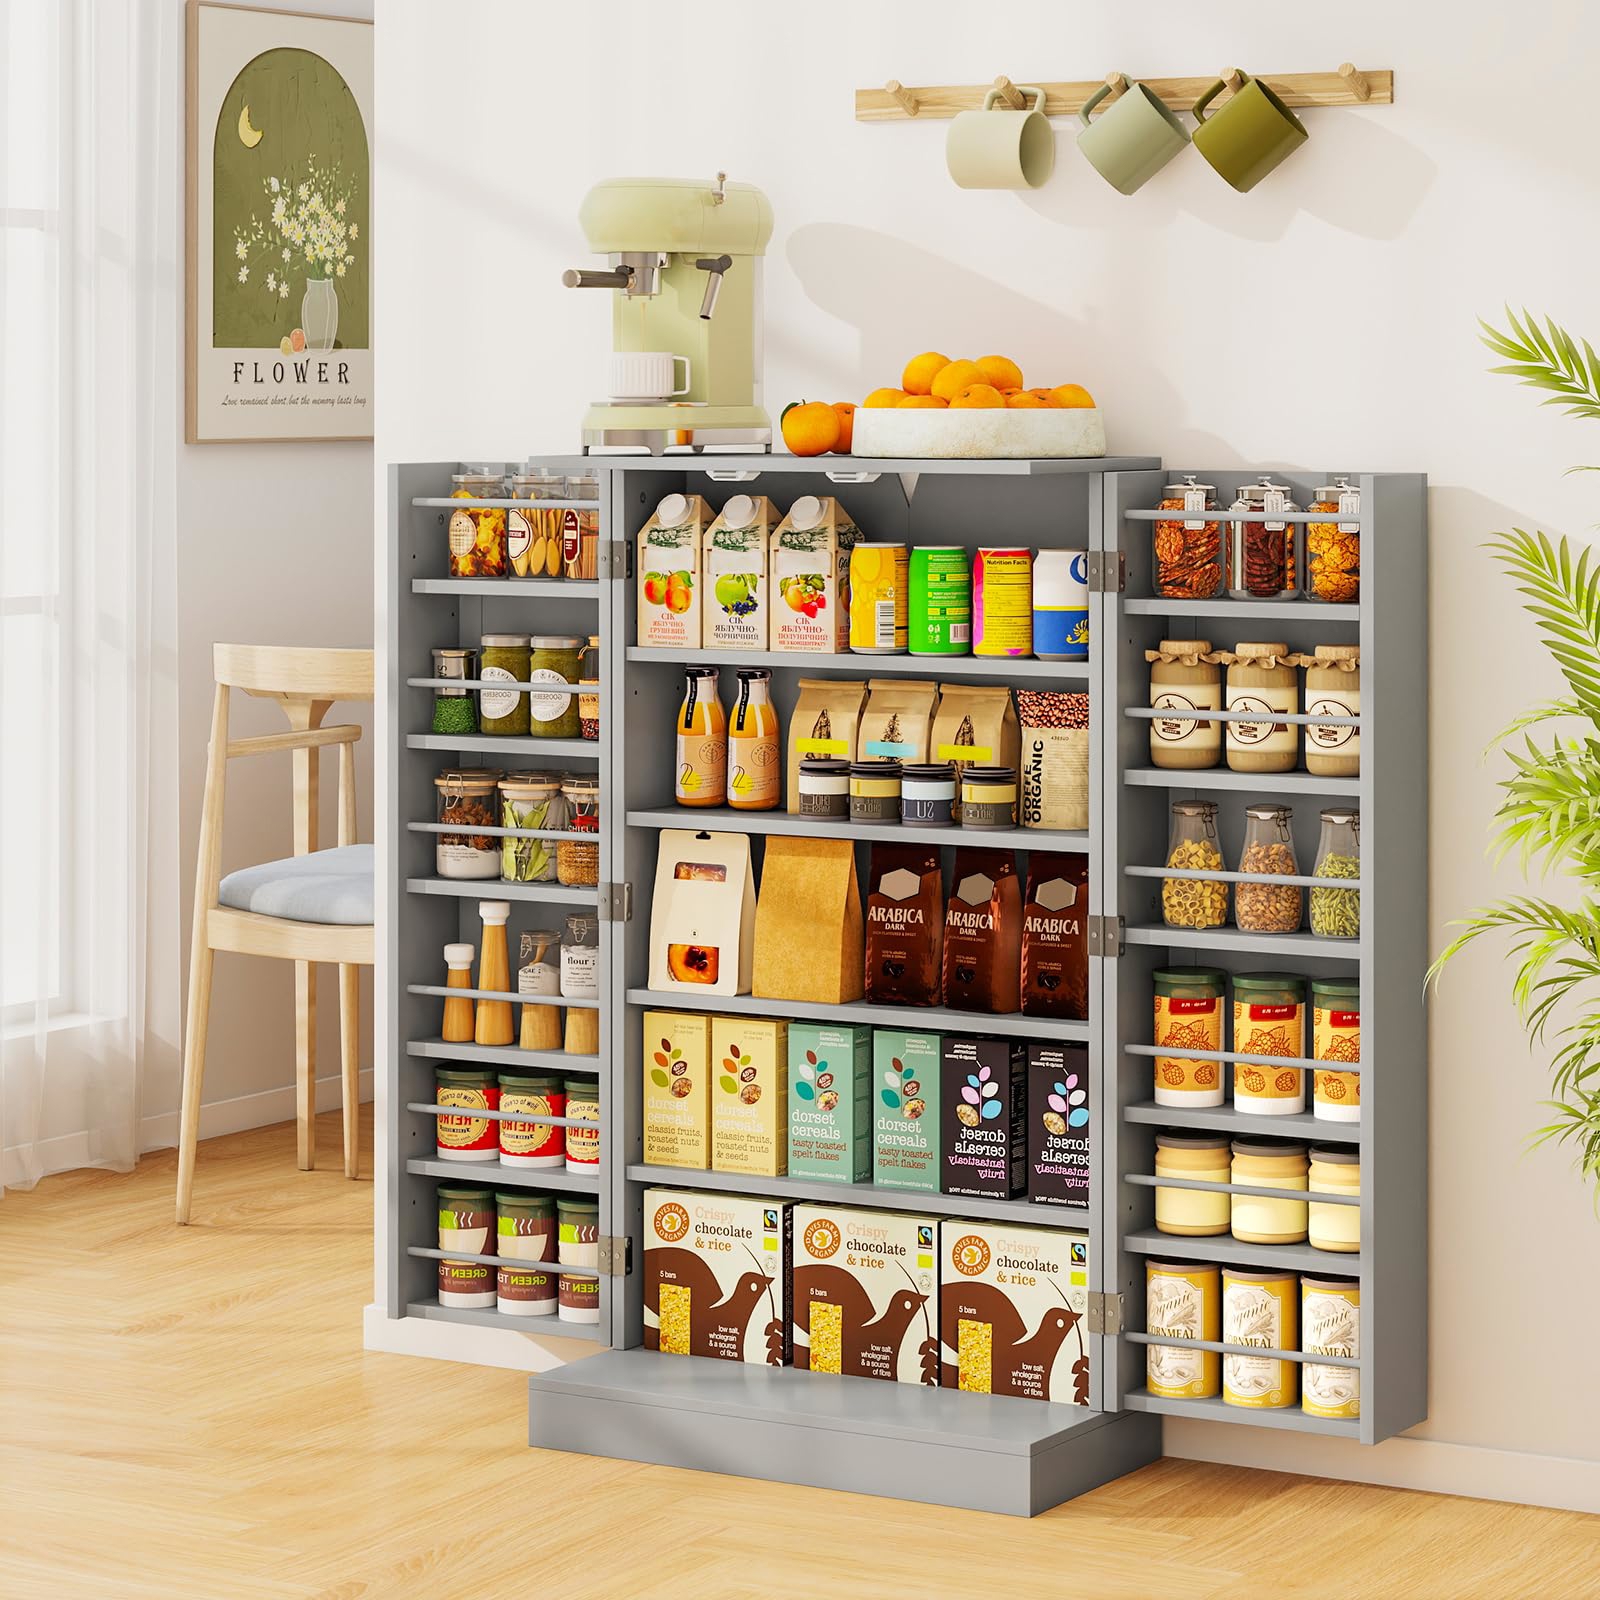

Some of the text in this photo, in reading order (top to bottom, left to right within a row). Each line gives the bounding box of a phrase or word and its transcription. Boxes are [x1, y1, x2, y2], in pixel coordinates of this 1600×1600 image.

[233, 358, 350, 384] FLOWER
[728, 616, 744, 625] СІК
[1031, 740, 1044, 823] ORGANIC
[867, 905, 924, 924] ARABICA
[946, 910, 993, 930] ARABICA
[884, 923, 905, 931] DARK
[959, 927, 977, 936] DARK
[1024, 915, 1080, 935] ARABICA
[1040, 933, 1061, 942] DARK
[567, 956, 589, 965] flour
[648, 1096, 688, 1112] dorset
[648, 1111, 695, 1126] cereals
[792, 1109, 835, 1125] dorset
[648, 1125, 703, 1138] classic fruits,
[877, 1117, 922, 1133] dorset
[716, 1132, 773, 1145] classic fruits,
[792, 1124, 841, 1140] cereals
[648, 1135, 700, 1147] roasted nuts
[792, 1139, 847, 1151] tasty toasted
[877, 1133, 928, 1148] cereals
[648, 1144, 679, 1155] & seeds
[716, 1142, 770, 1154] roasted nuts
[878, 1147, 934, 1160] tasty toasted
[716, 1151, 749, 1162] & seeds
[792, 1149, 840, 1161] spelt flakes
[878, 1157, 926, 1170] spelt flakes
[655, 1205, 687, 1227] DOVES FARM
[695, 1206, 735, 1224] Crispy
[659, 1224, 688, 1241] ORGANIC
[695, 1222, 753, 1239] chocolate
[805, 1221, 839, 1244] DOVES FARM
[846, 1223, 889, 1241] Crispy
[695, 1237, 732, 1252] & rice
[809, 1241, 840, 1258] ORGANIC
[846, 1239, 907, 1257] chocolate
[953, 1237, 988, 1262] DOVES FARM
[996, 1239, 1040, 1258] Crispy
[846, 1254, 885, 1269] & rice
[957, 1257, 989, 1275] ORGANIC
[996, 1255, 1059, 1273] chocolate
[660, 1270, 677, 1279] 5 bars
[996, 1271, 1036, 1287] & rice
[810, 1288, 827, 1297] 5 bars
[959, 1305, 977, 1315] 5 bars
[1153, 1290, 1193, 1321] rganic
[718, 1325, 728, 1333] low
[709, 1332, 737, 1343] wholegrain
[720, 1349, 738, 1358] of fibre
[870, 1344, 880, 1352] low
[1304, 1344, 1354, 1358] ORNMEAL
[861, 1351, 890, 1362] wholegrain
[872, 1368, 891, 1377] of fibre
[1021, 1362, 1031, 1371] low
[1011, 1370, 1042, 1381] wholegrain
[1022, 1381, 1042, 1389] source
[1023, 1387, 1043, 1397] of fibre
